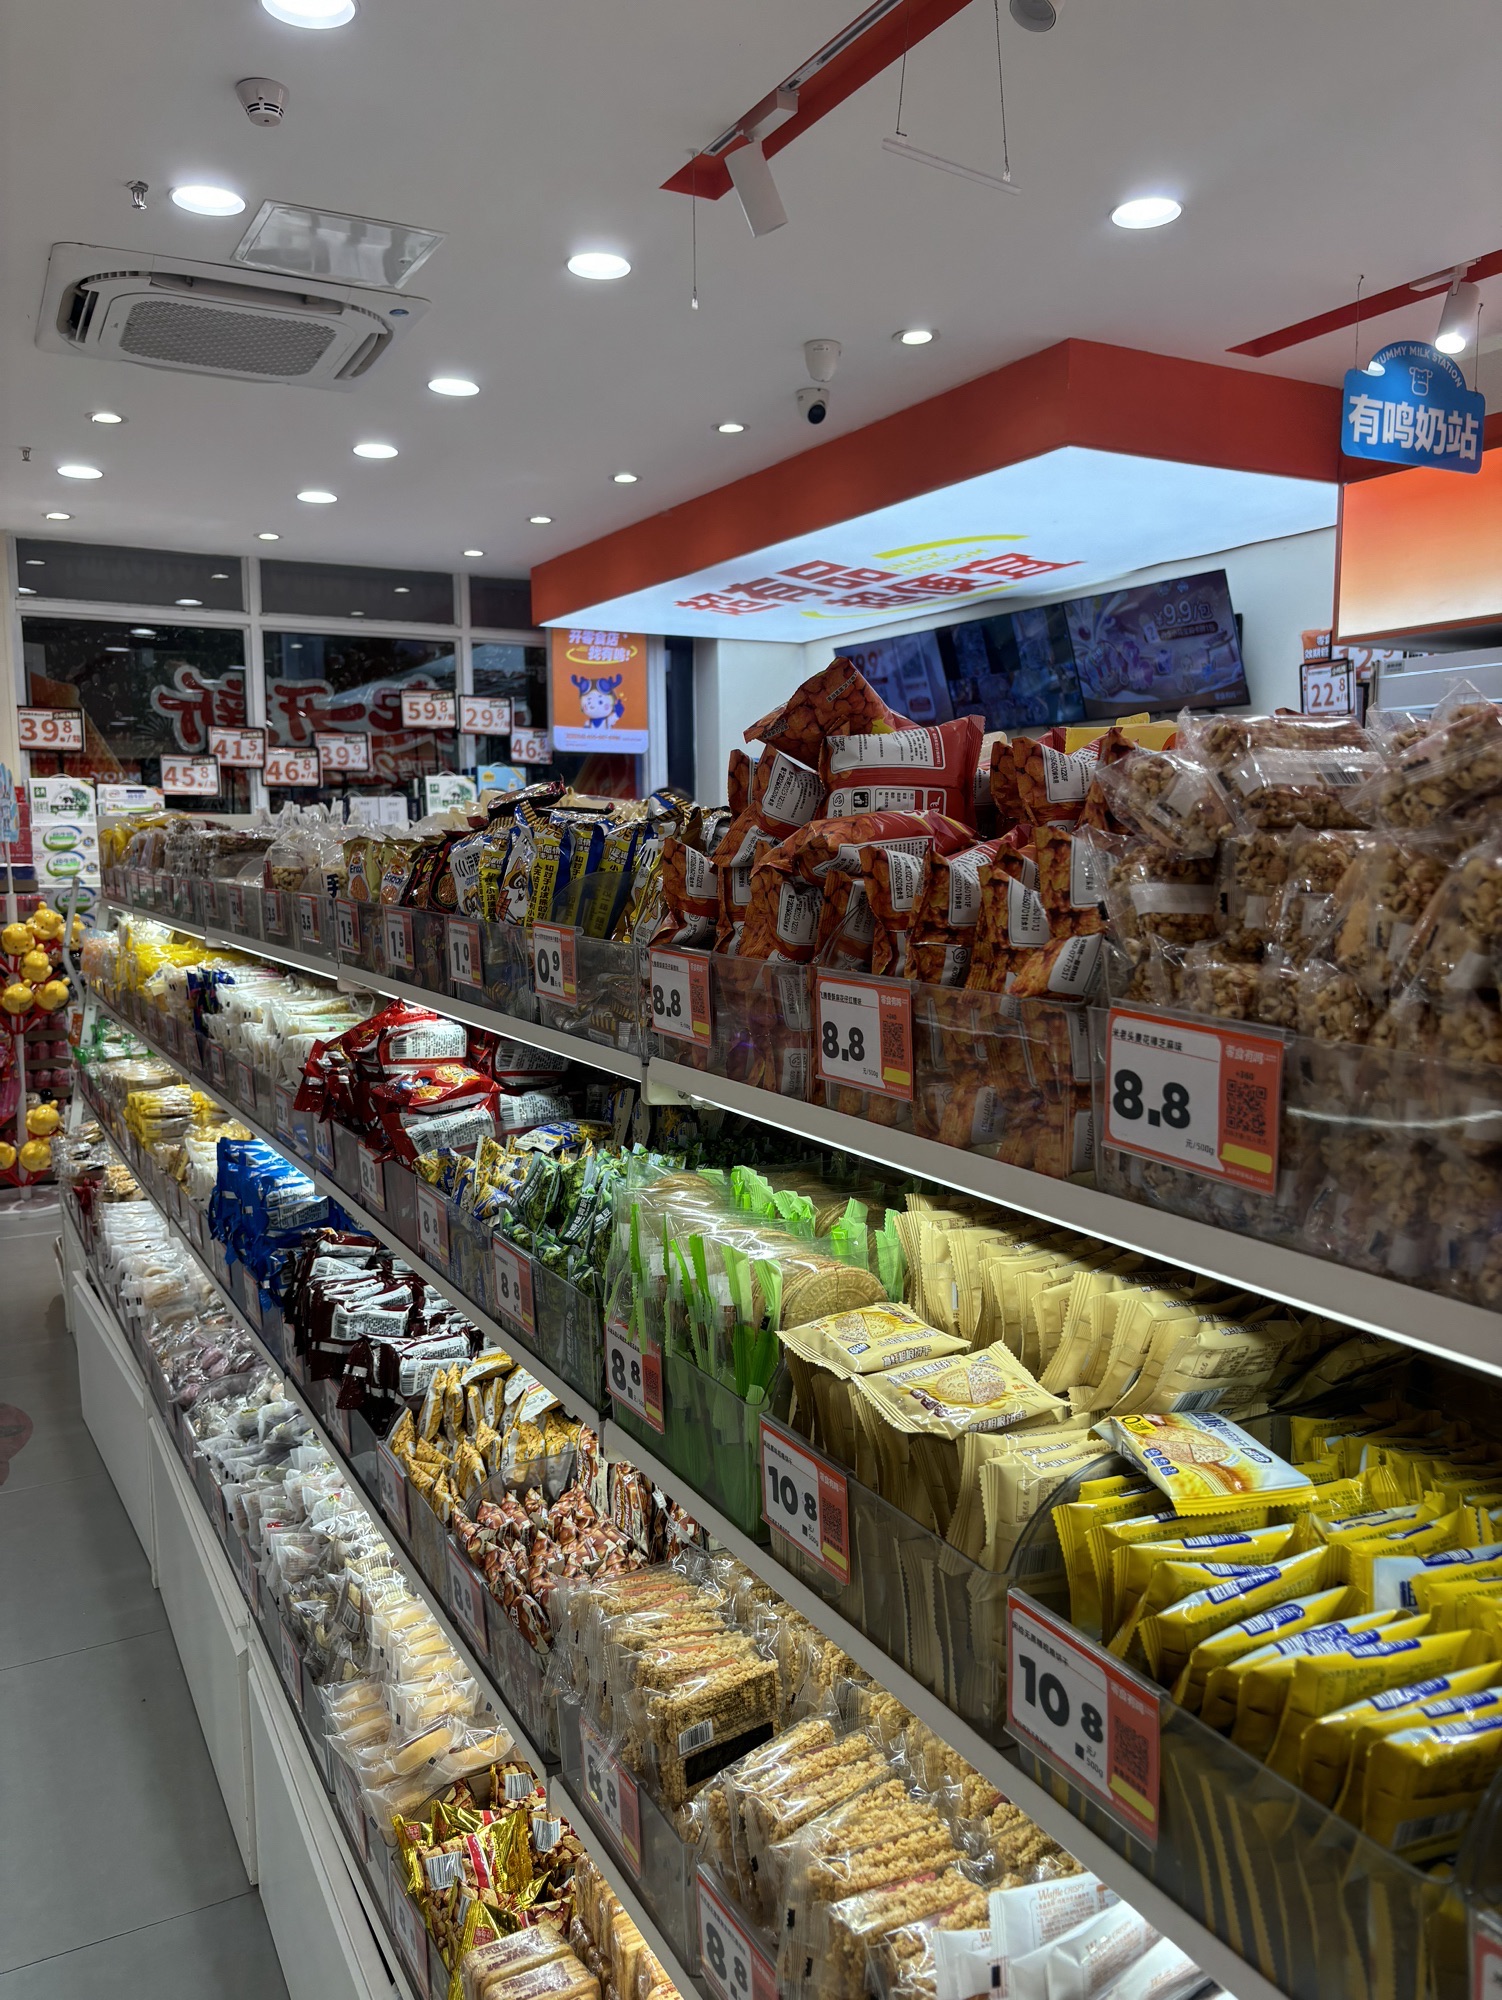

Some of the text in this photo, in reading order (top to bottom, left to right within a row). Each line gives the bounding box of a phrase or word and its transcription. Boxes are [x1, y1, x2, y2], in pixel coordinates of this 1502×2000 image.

[1409, 346, 1430, 359] MILK
[1432, 353, 1463, 388] STATION
[1348, 393, 1479, 460] 有鸣奶站
[408, 702, 448, 720] 59.8
[466, 708, 504, 728] 29.8
[20, 718, 73, 742] 39.8
[213, 739, 258, 760] 41.5
[320, 744, 361, 766] 39.9
[163, 766, 210, 787] 45.8
[266, 759, 311, 781] 46.8
[652, 984, 682, 1017] 8.8
[822, 1021, 865, 1062] 8.8
[1112, 1069, 1191, 1130] 8.8
[1185, 1138, 1215, 1156] 元/500g
[881, 1345, 932, 1368] 高纤粗粮饼干
[611, 1348, 641, 1400] 8.8
[768, 1465, 818, 1537] 10.8
[1018, 1653, 1104, 1761] 10.8
[1086, 1758, 1104, 1779] 500g
[1037, 1886, 1064, 1900] Waffle
[706, 1922, 748, 1998] 8.8
